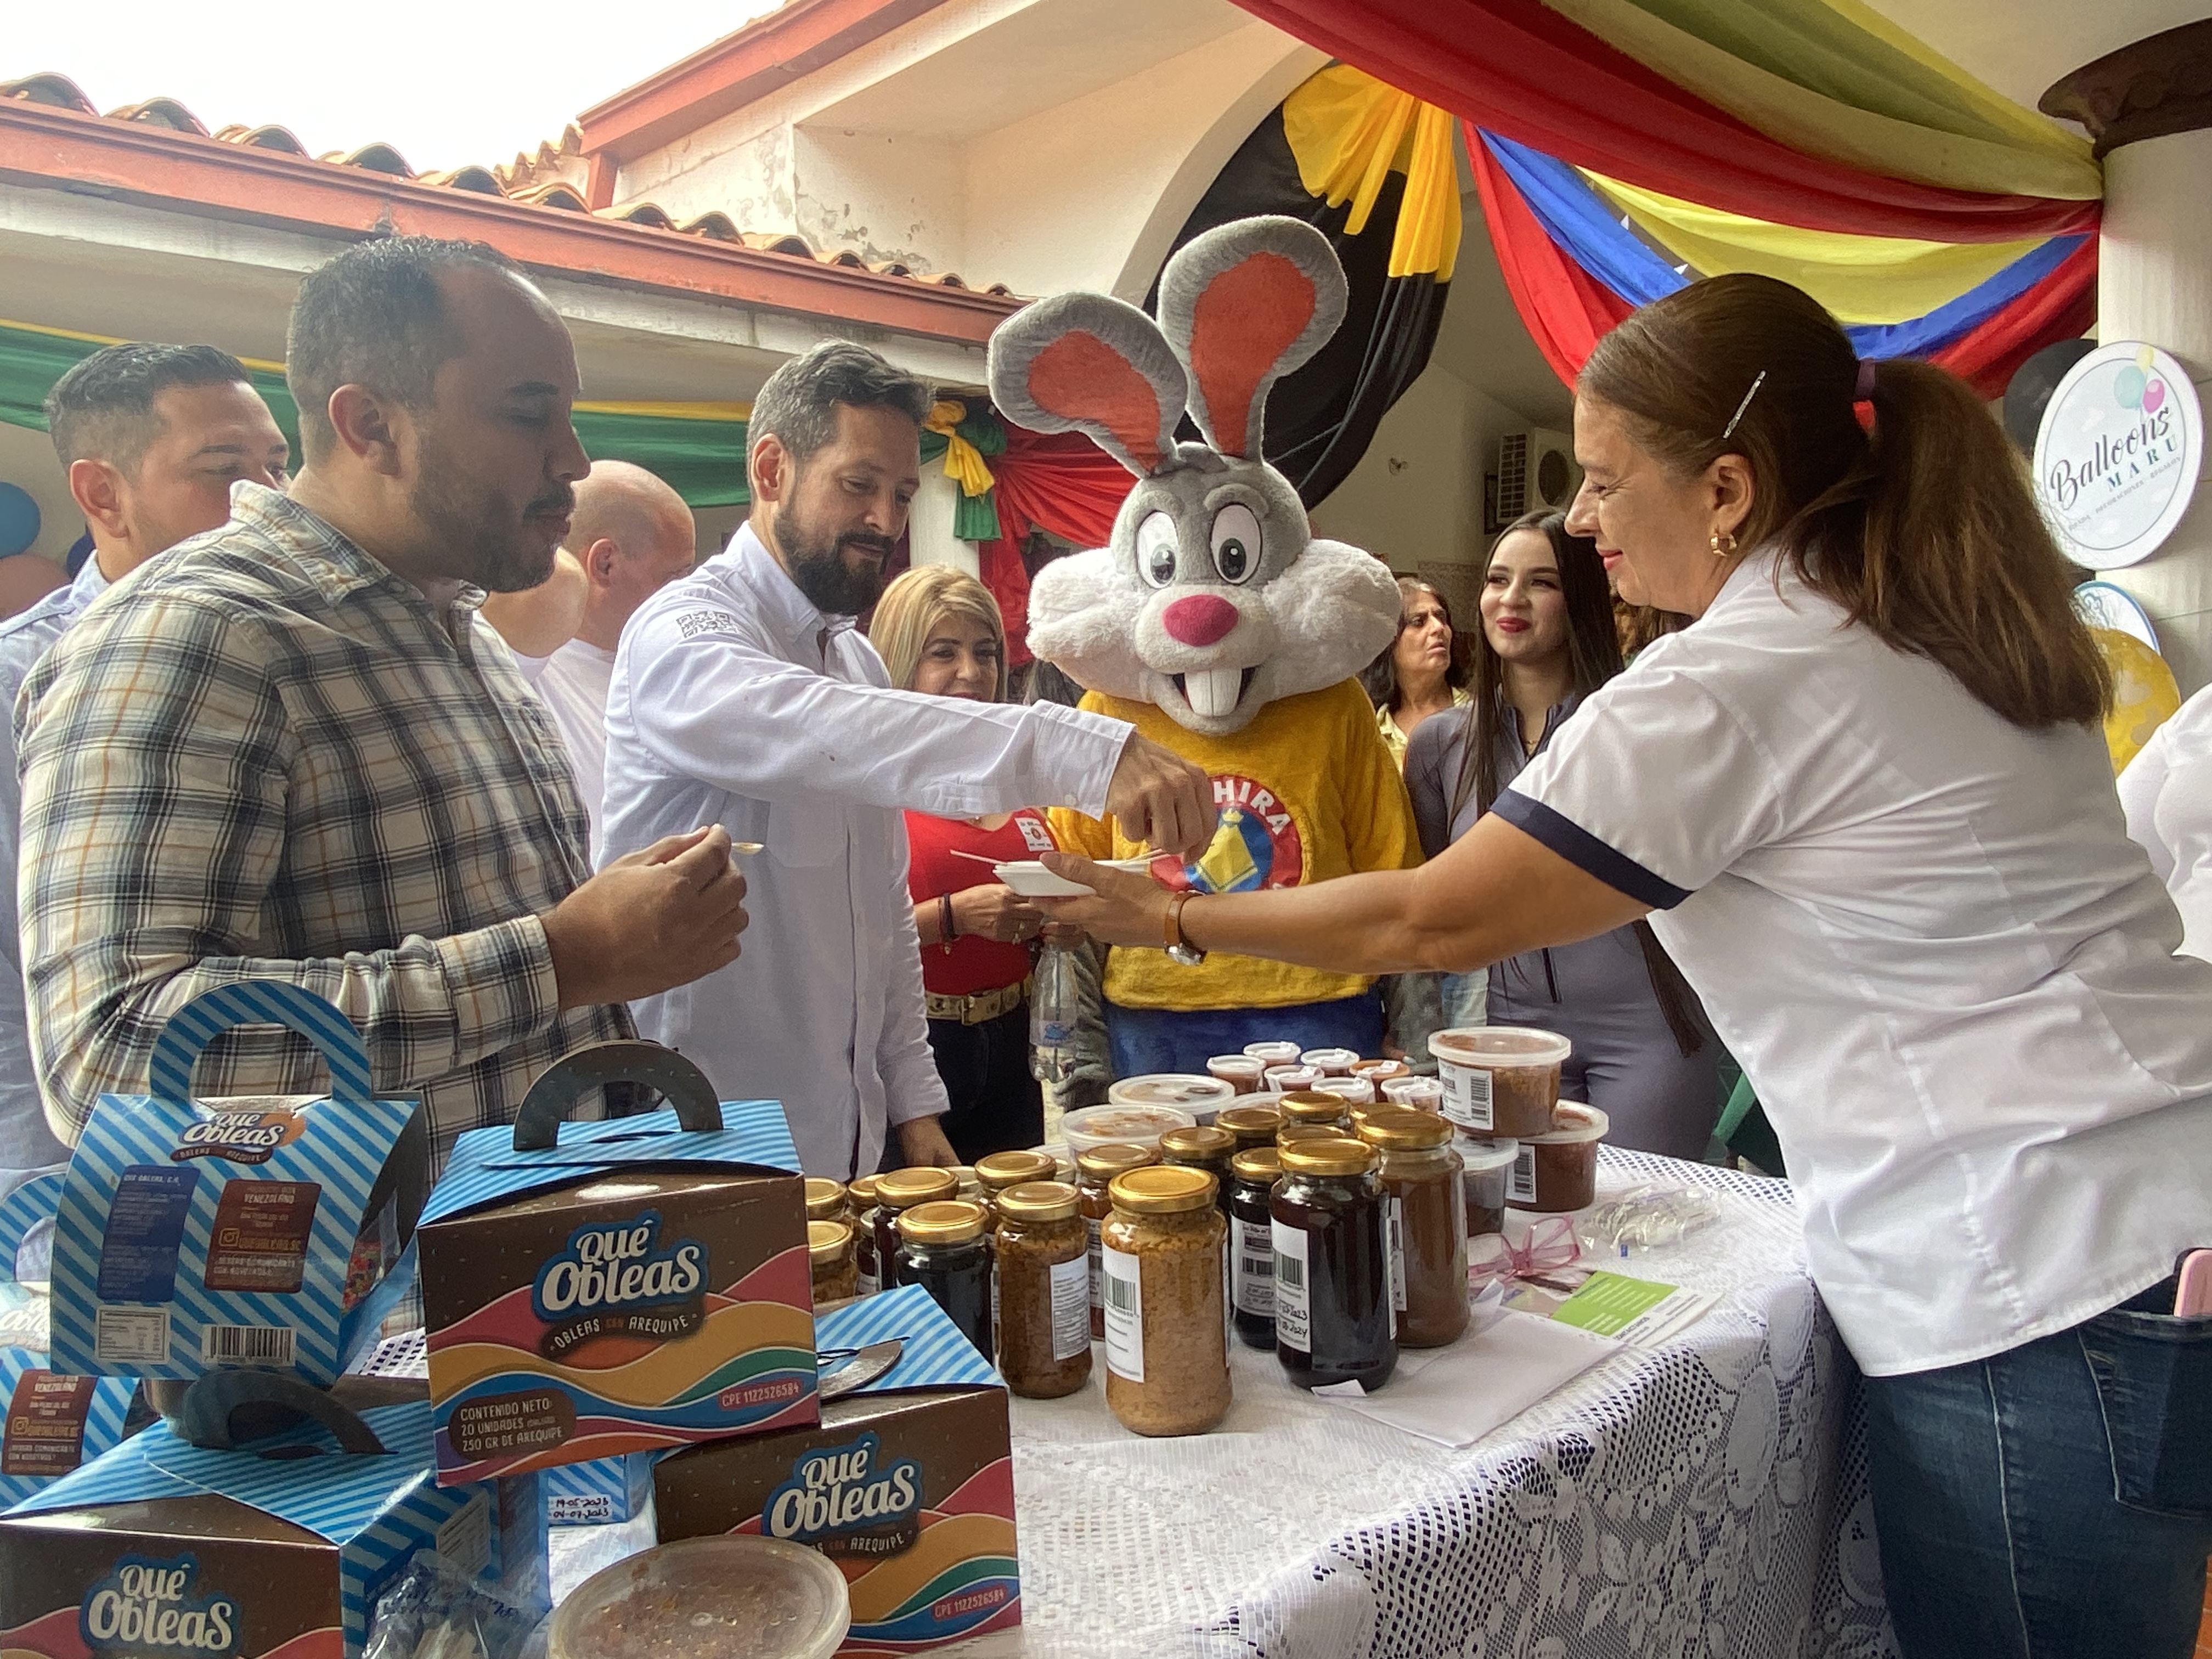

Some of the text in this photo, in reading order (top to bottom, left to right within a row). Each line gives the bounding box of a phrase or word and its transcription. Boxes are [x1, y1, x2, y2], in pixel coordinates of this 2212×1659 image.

[2051, 407, 2171, 511] Balloons
[2107, 434, 2177, 493] MARU
[1212, 778, 1291, 836] HIRA
[576, 1219, 653, 1266] Qué
[542, 1245, 700, 1311] Obleas
[554, 1318, 600, 1348] OBLEAS
[629, 1315, 689, 1334] AREQUIPE
[460, 1402, 519, 1421] CONTENIDO
[722, 1392, 741, 1407] CPE
[461, 1424, 475, 1437] 20
[477, 1417, 524, 1434] UNIDADES
[462, 1426, 563, 1452] 250 GR DE AREQUIPE
[802, 1442, 872, 1491] Qué
[770, 1464, 915, 1537] Obleas
[850, 1533, 905, 1553] AREQUIPE
[120, 1563, 191, 1602] Qué
[88, 1589, 232, 1651] Obleas
